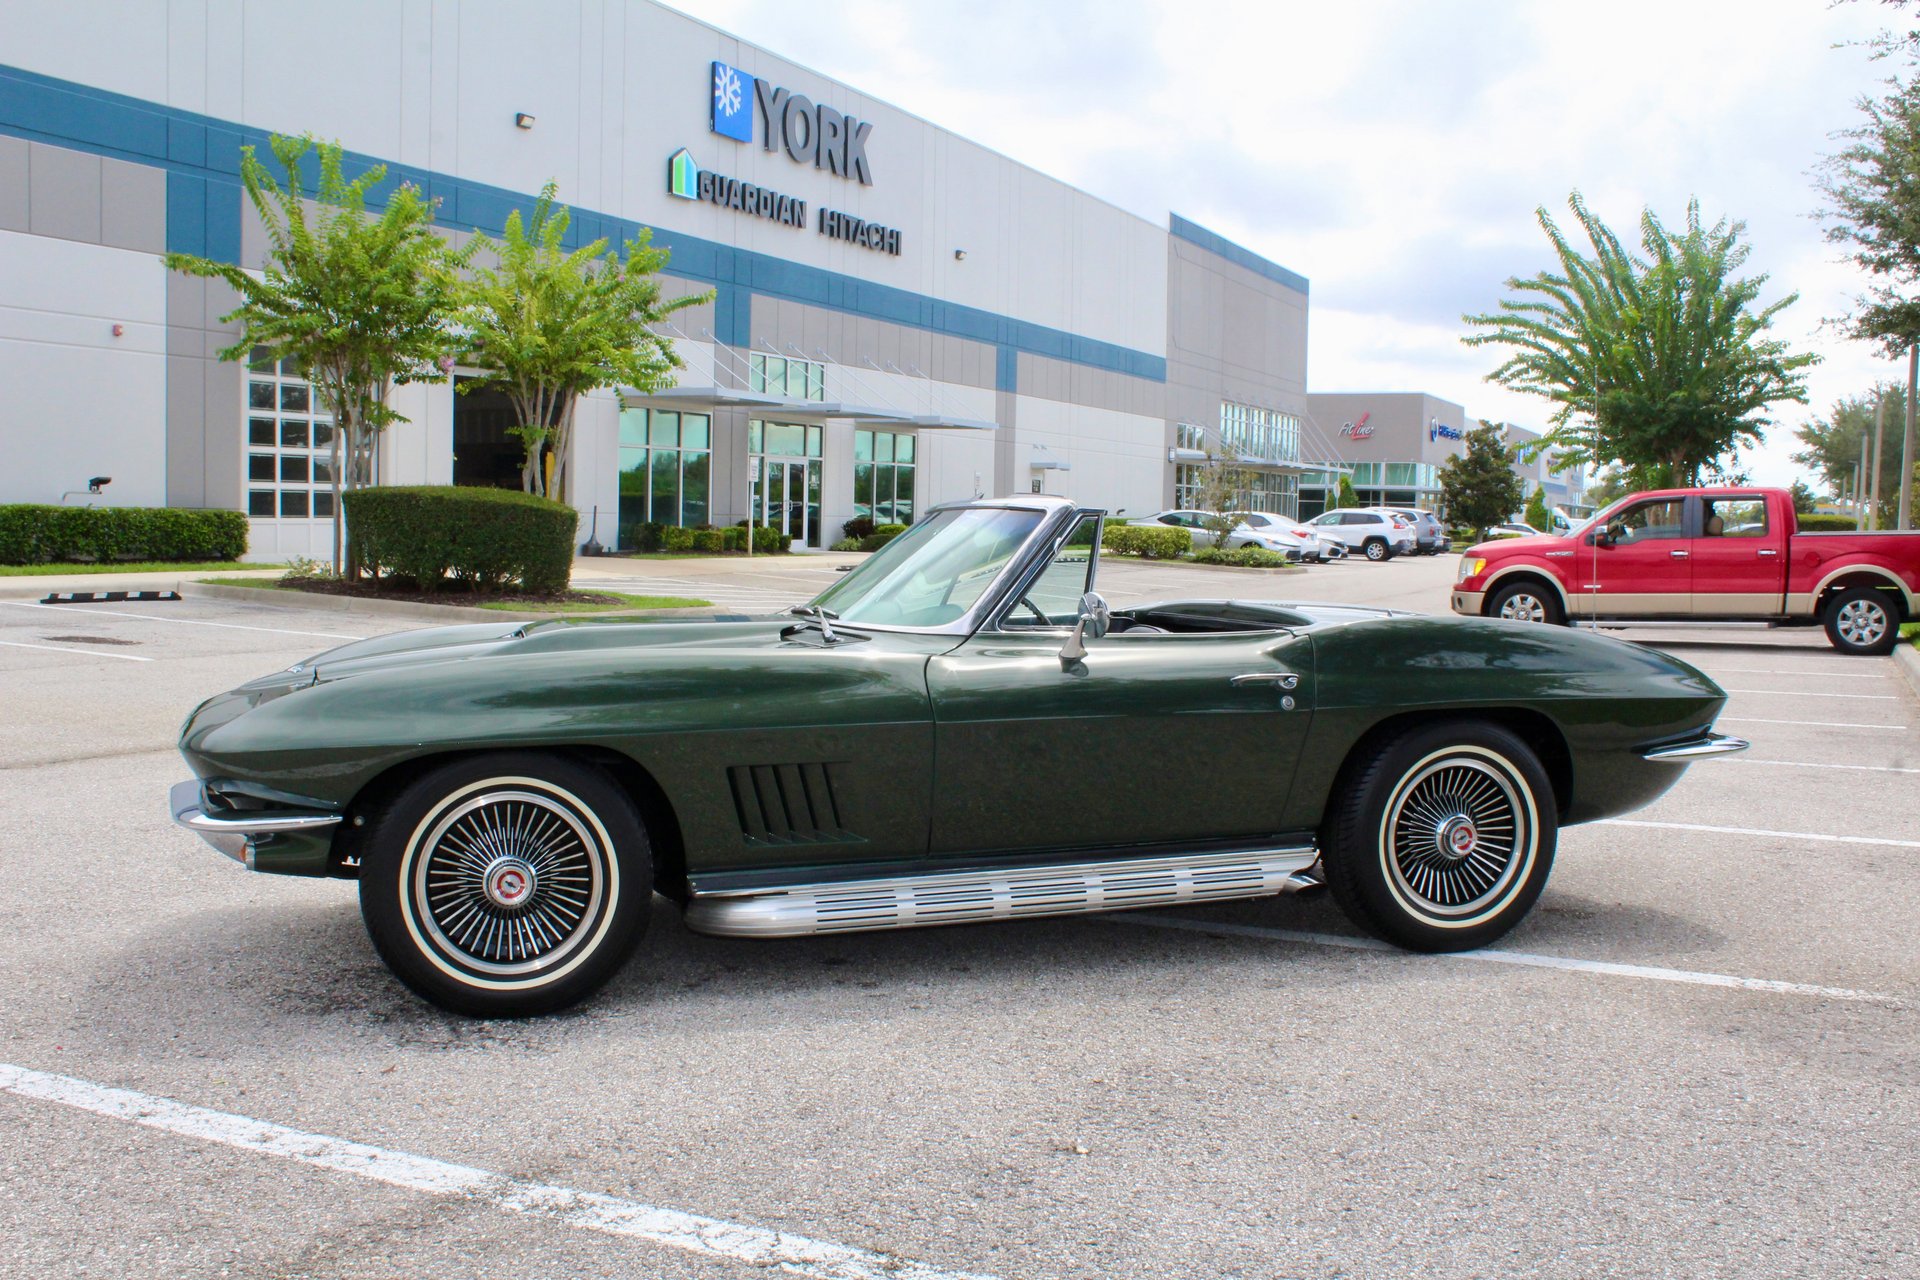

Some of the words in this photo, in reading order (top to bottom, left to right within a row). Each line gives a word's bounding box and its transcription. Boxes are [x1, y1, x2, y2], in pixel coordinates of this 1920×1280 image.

[754, 78, 873, 186] YORK
[698, 170, 807, 229] GUARDIAN
[819, 208, 902, 256] HITACHI
